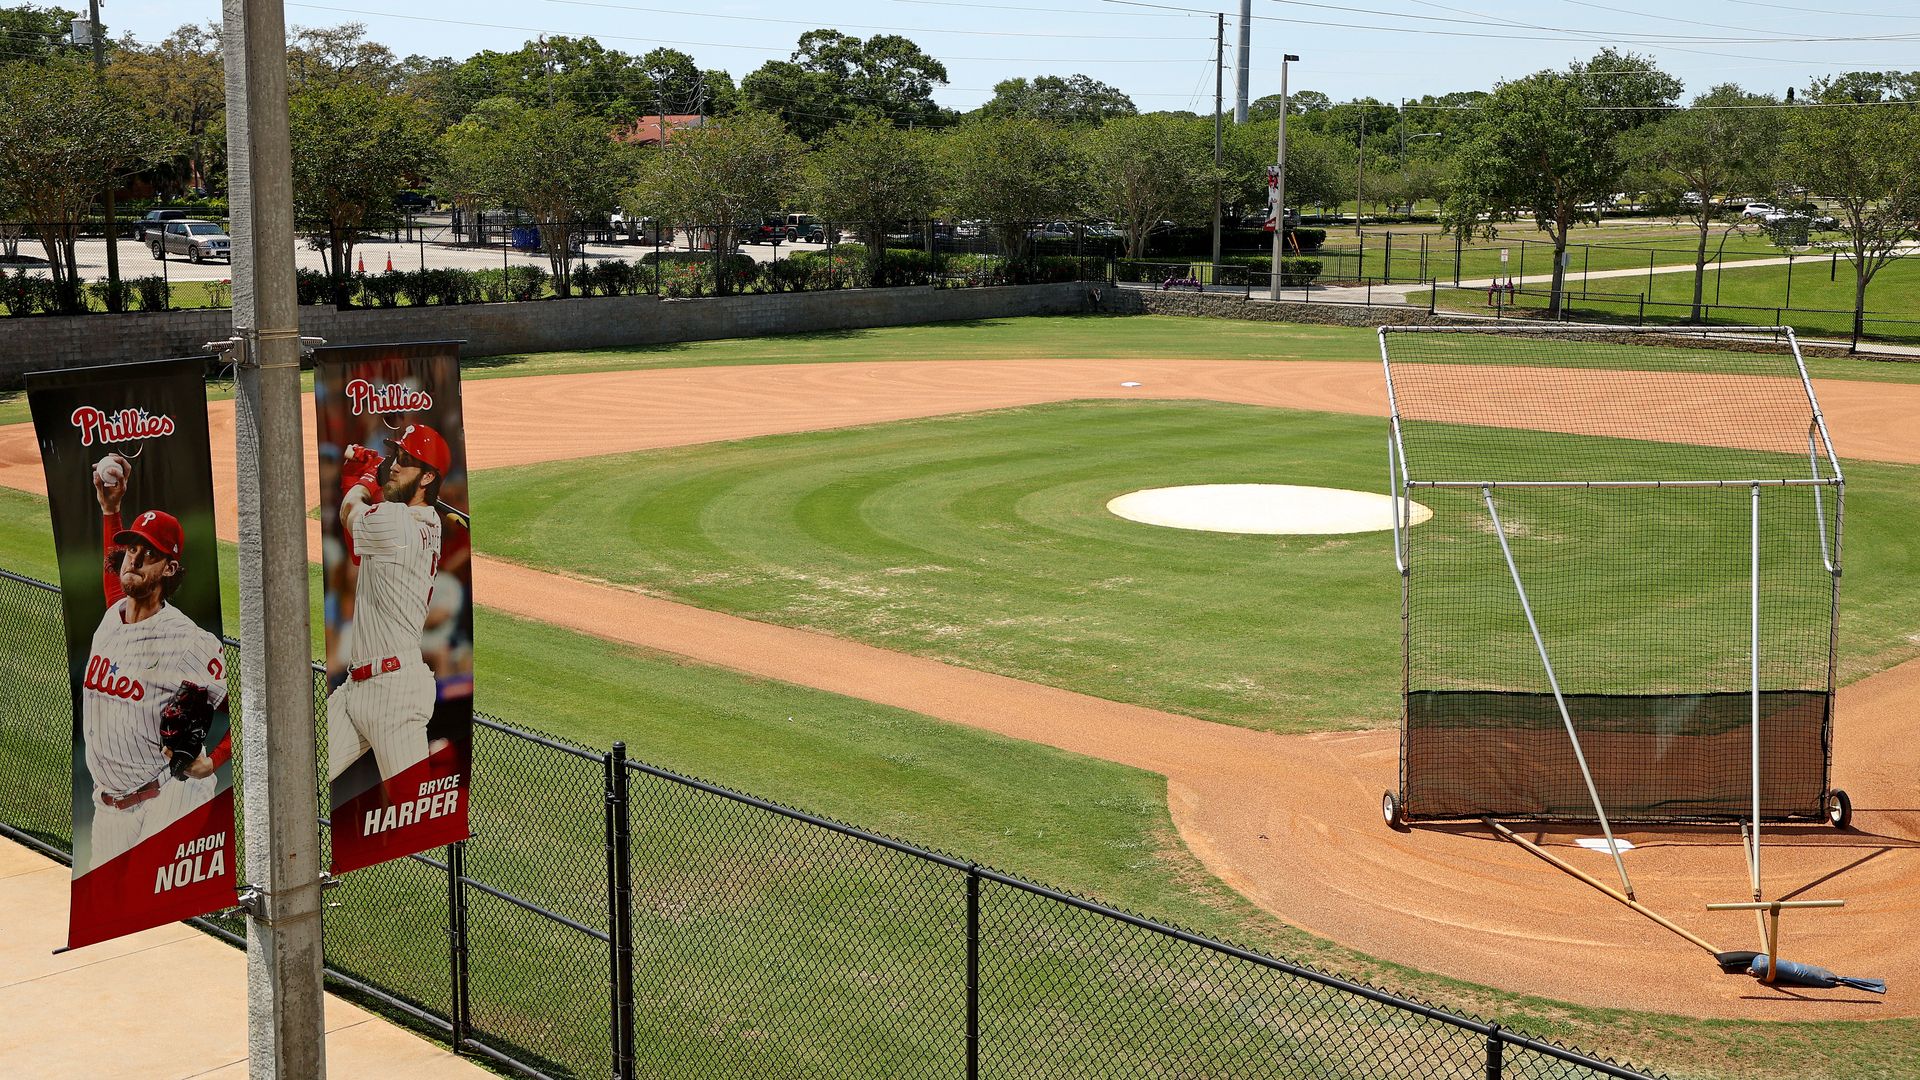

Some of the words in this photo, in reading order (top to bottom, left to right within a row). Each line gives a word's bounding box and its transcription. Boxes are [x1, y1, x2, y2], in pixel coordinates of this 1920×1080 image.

[346, 379, 432, 415] Phillies
[71, 406, 175, 446] Phillies
[418, 774, 460, 796] BRYCE
[363, 790, 459, 837] HARPER
[174, 831, 226, 860] AARON
[154, 849, 225, 894] NOLA
